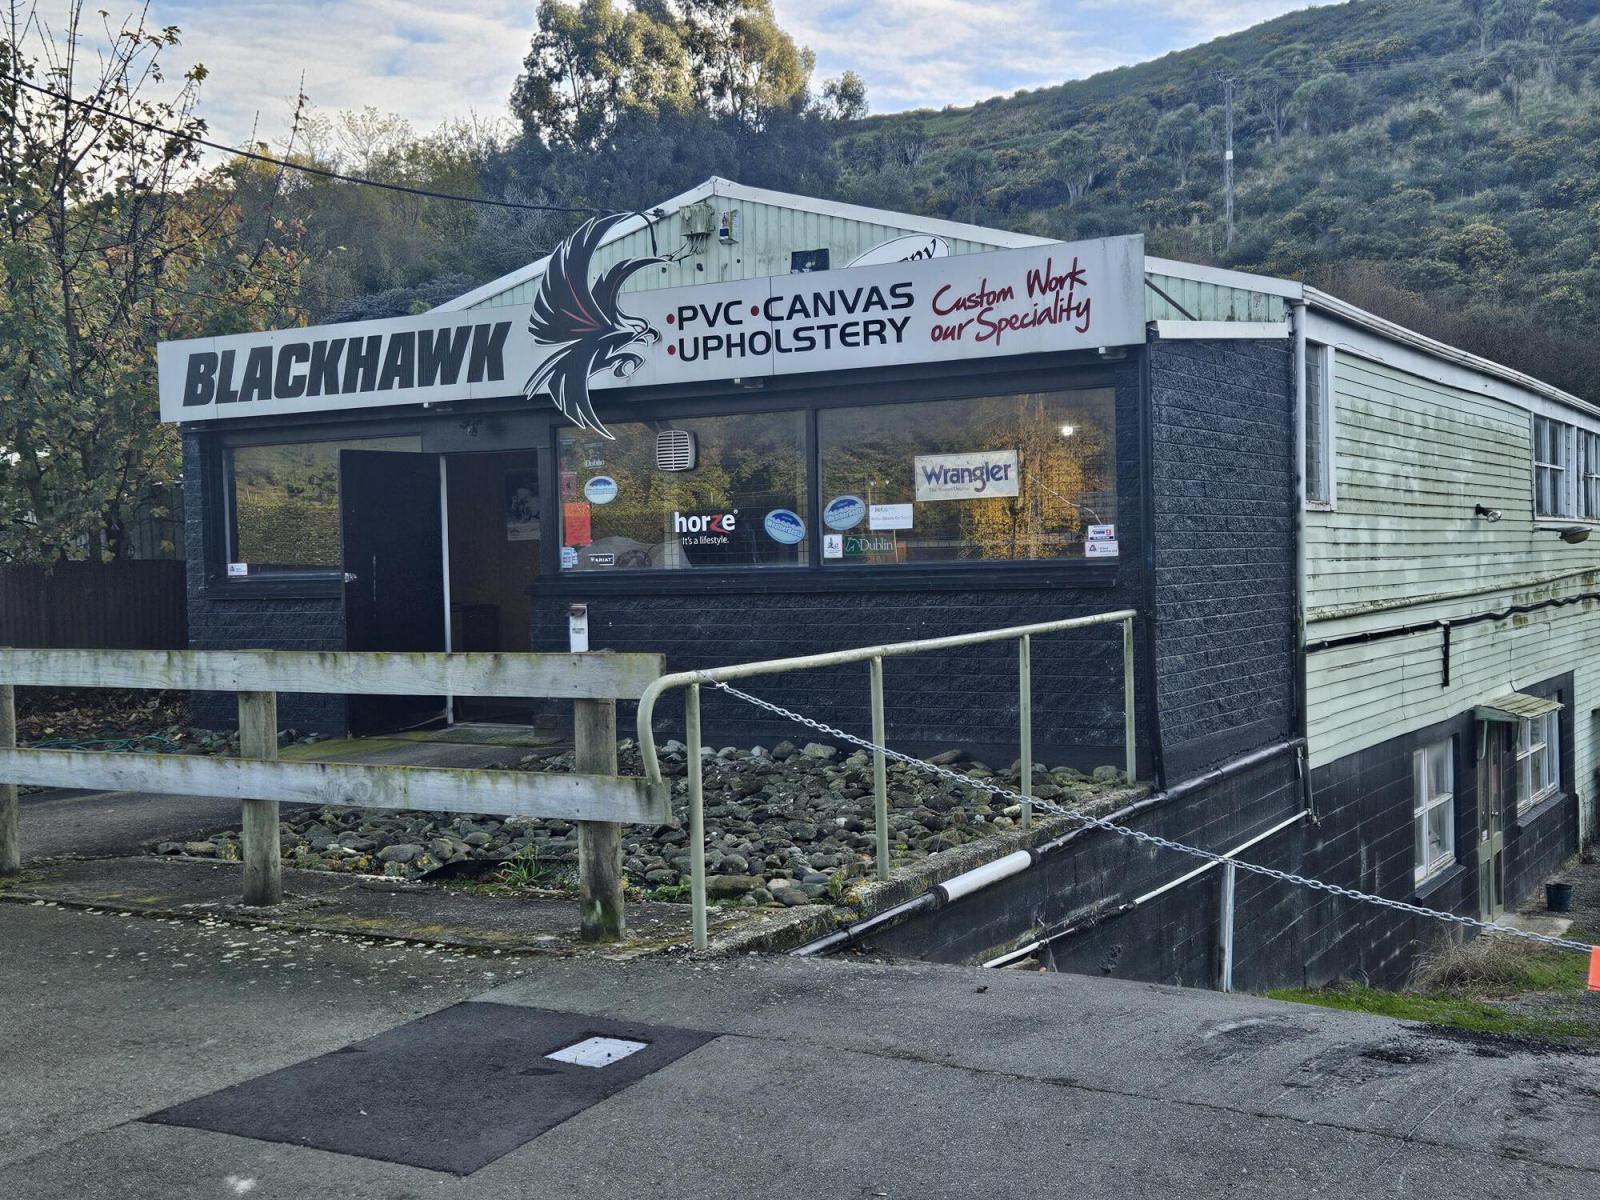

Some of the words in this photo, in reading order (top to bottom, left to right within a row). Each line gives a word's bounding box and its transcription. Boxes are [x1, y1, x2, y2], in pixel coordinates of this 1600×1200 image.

[678, 300, 743, 331] PVC
[763, 282, 915, 322] CANVAS
[931, 278, 1015, 316] Custom
[1026, 256, 1088, 298] Work
[679, 316, 912, 362] UPHOLSTERY
[930, 318, 975, 342] our
[975, 290, 1091, 346] Speciality
[183, 321, 513, 407] BLACKHAWK
[921, 461, 1011, 492] Wrangler
[674, 511, 736, 535] horze
[860, 538, 893, 551] Dublin
